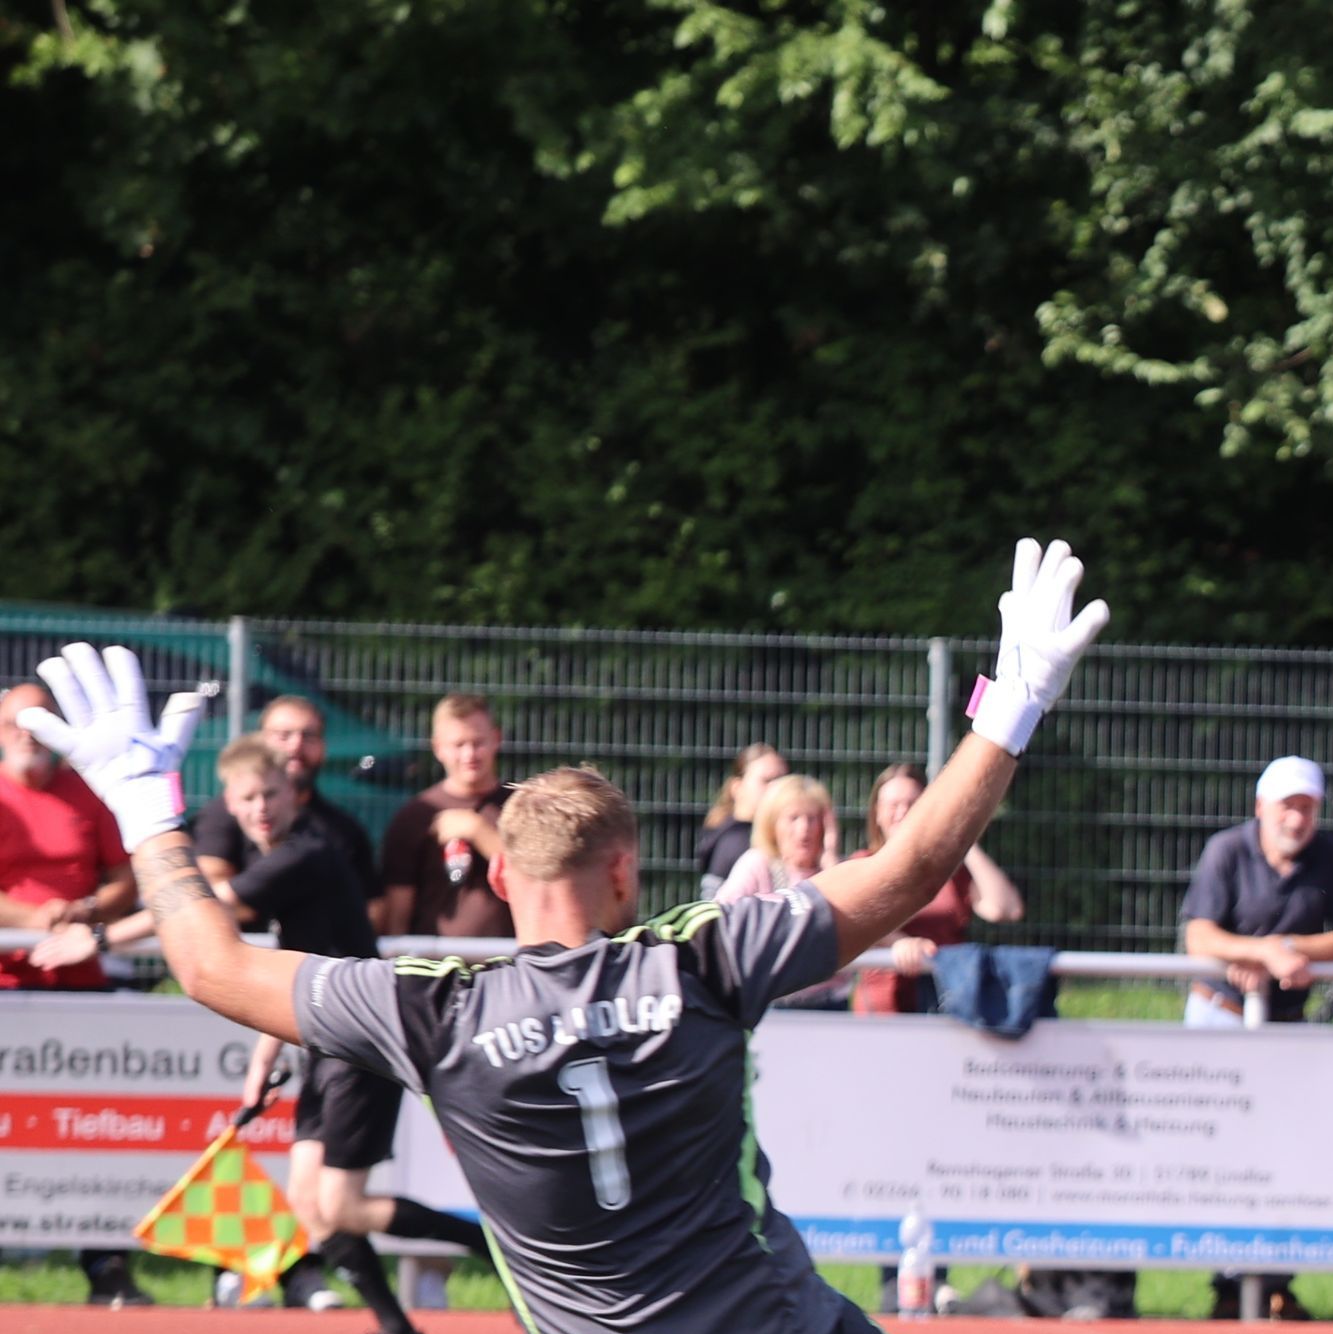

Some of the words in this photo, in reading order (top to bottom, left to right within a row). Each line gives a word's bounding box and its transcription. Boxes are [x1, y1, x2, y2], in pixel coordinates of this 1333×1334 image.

[466, 1015, 546, 1067] TUS
[53, 1108, 165, 1140] Tiefbau
[558, 1056, 631, 1211] 1
